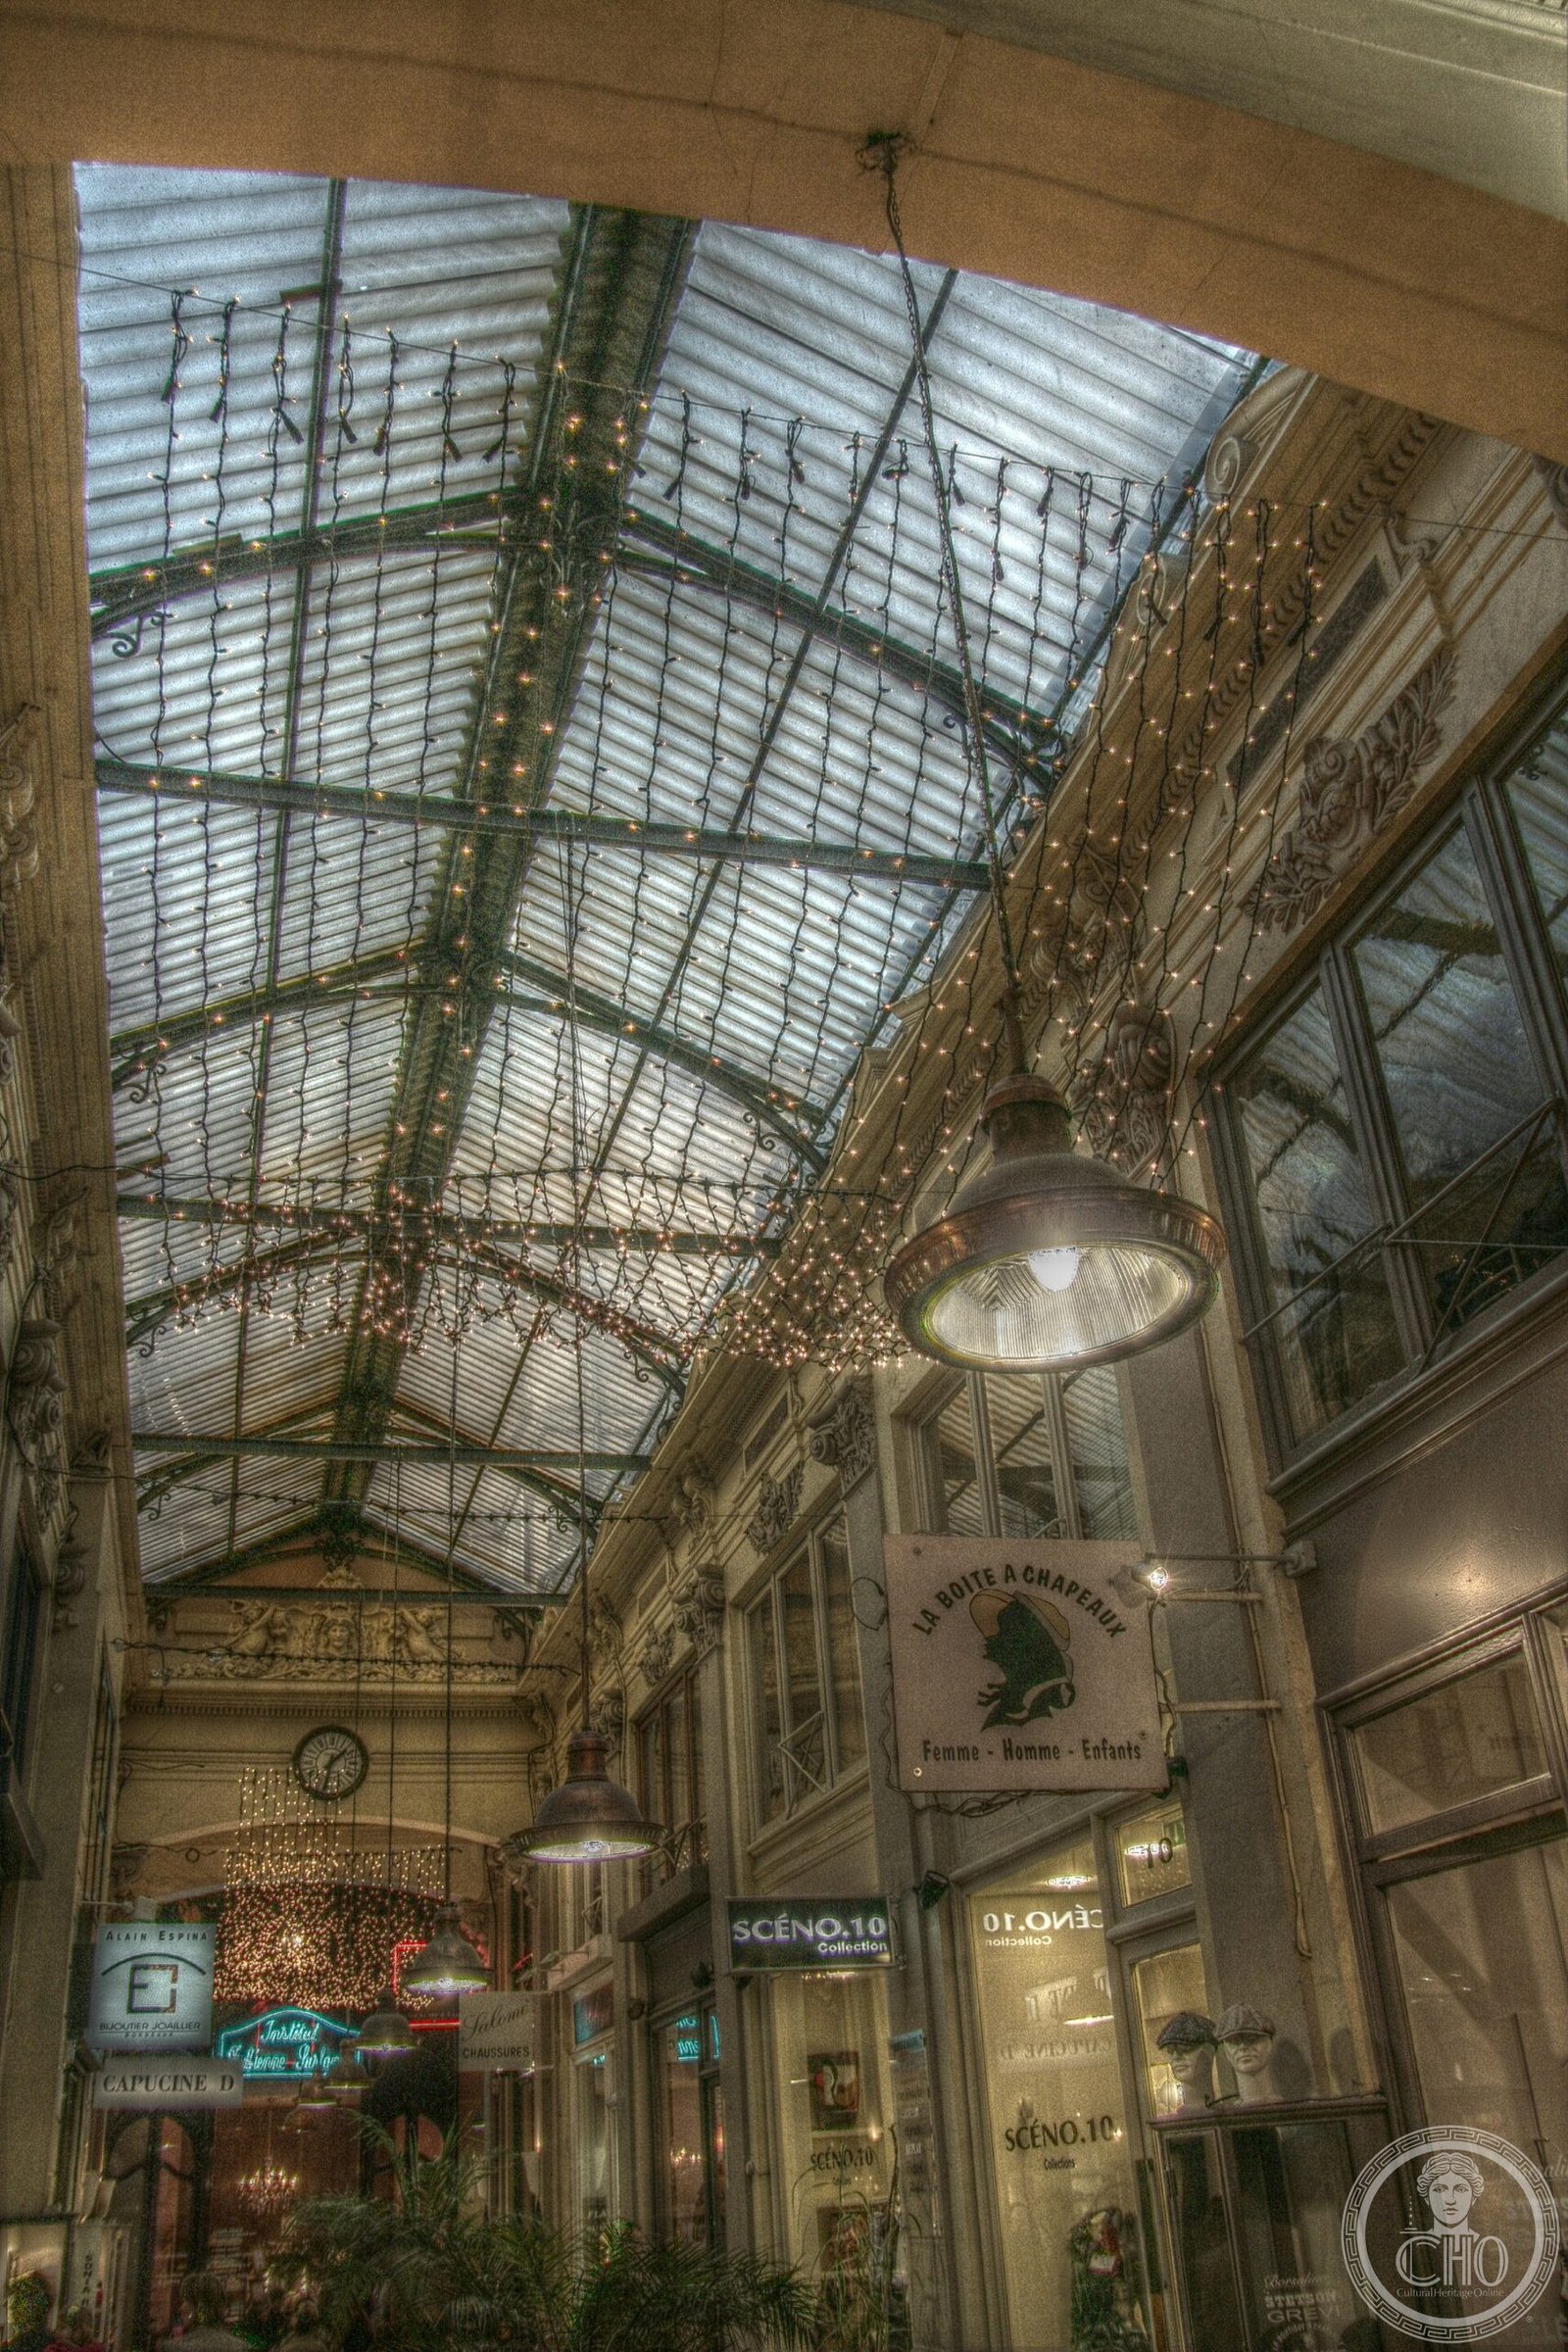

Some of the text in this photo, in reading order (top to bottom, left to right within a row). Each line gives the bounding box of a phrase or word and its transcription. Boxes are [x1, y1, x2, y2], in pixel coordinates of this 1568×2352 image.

[912, 1564, 1127, 1639] LA BOITE A CHAPEAUX
[922, 1740, 979, 1762] Femme
[1003, 1739, 1060, 1761] Homme
[1082, 1738, 1141, 1760] Enfants
[733, 1913, 886, 1941] SCÉNO.10
[817, 1940, 887, 1954] Collection
[99, 2022, 149, 2032] BIJOUTIER
[260, 2020, 320, 2041] Institut
[463, 2046, 529, 2058] CHAUSSURES
[103, 2074, 234, 2092] CAPUCINE D
[1004, 2115, 1113, 2151] SCÉNO.10
